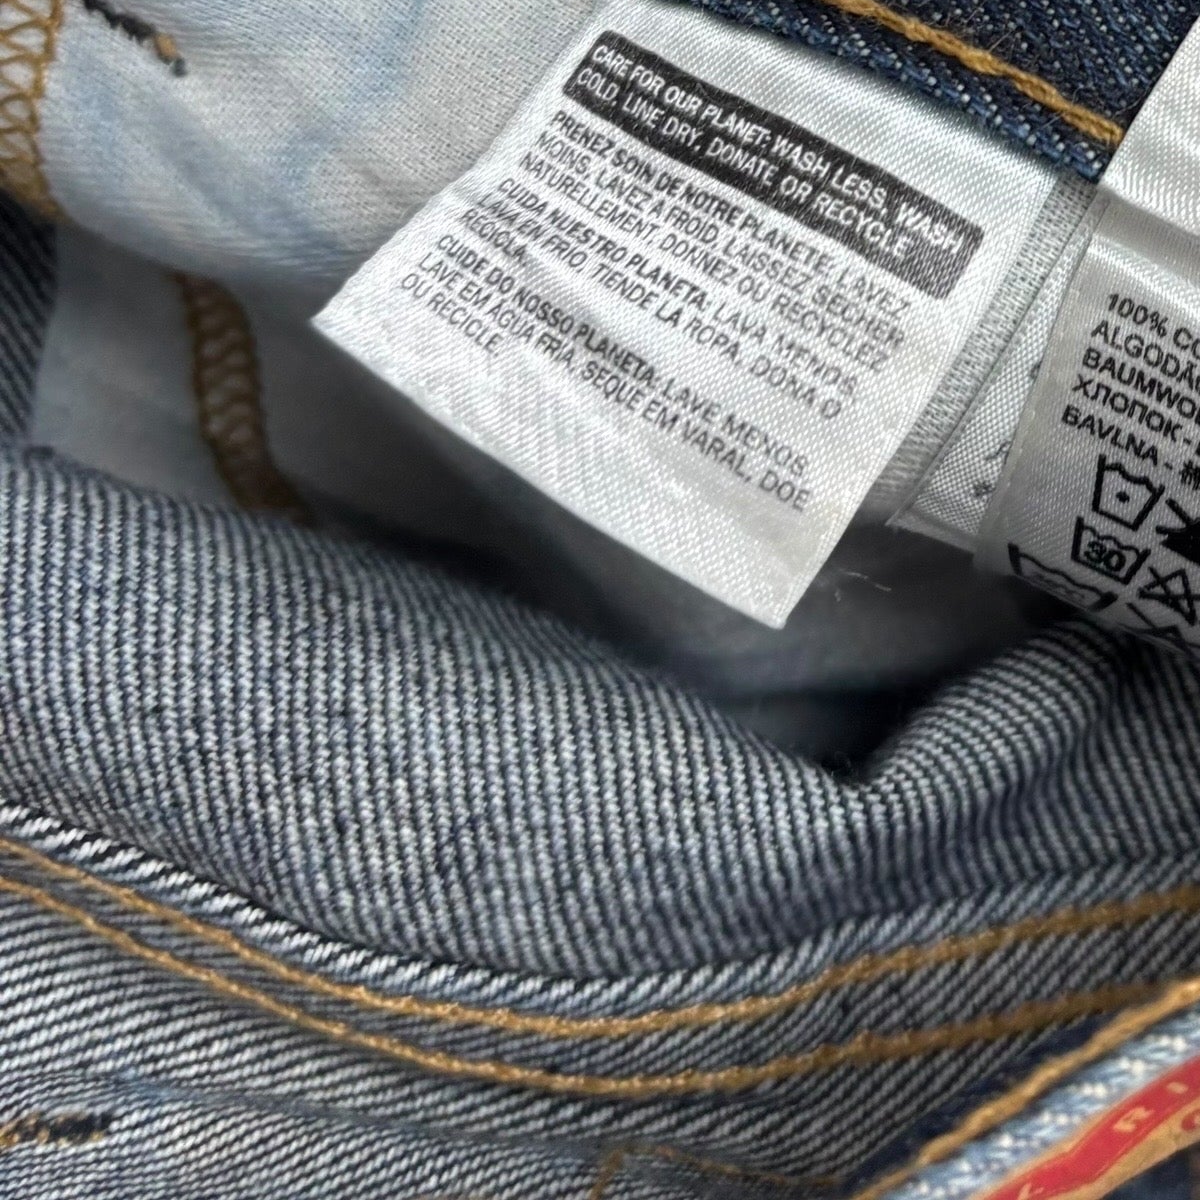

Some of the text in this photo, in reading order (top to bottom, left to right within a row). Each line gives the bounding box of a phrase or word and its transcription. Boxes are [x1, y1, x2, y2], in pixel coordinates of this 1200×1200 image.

[519, 151, 661, 246] NATURELLEMENT,
[659, 232, 739, 287] DONNEZ
[736, 274, 773, 303] OU
[535, 130, 592, 180] MOINS,
[595, 168, 653, 211] LAVEZ
[664, 205, 719, 250] FROID,
[722, 236, 812, 293] LAISSEZ
[549, 110, 616, 160] PRENEZ
[611, 149, 657, 184] SOIN
[654, 171, 685, 197] DE
[679, 182, 744, 227] NOTRE
[836, 267, 911, 318] LAVEZ
[577, 67, 914, 257] COLD, LINE DRY, DONATE OR RECYCLE
[593, 45, 966, 255] CARE FOR OUR PLANET: WASH LESS, WASH
[400, 272, 434, 299] OU
[418, 251, 464, 291] LAVE
[458, 280, 493, 309] EM
[580, 360, 646, 411] SEQUE
[641, 400, 681, 432] EM
[681, 420, 752, 482] VARAL,
[758, 469, 811, 512] DOE
[437, 234, 490, 277] CUIDE
[485, 266, 516, 295] DO
[511, 287, 576, 335] NOSSO
[661, 378, 722, 424] LAVE
[720, 413, 810, 478] MENOS
[476, 193, 519, 227] LAVA
[516, 219, 547, 243] EN
[591, 262, 660, 311] TIENDE
[654, 299, 685, 329] LA
[750, 354, 817, 408] DONA
[497, 177, 549, 216] CUIDA
[545, 206, 628, 263] NUESTRO
[713, 301, 767, 344] LAVA
[771, 333, 858, 397] MENOS
[1108, 293, 1169, 339] 100%
[1061, 403, 1159, 467] BAVLNA
